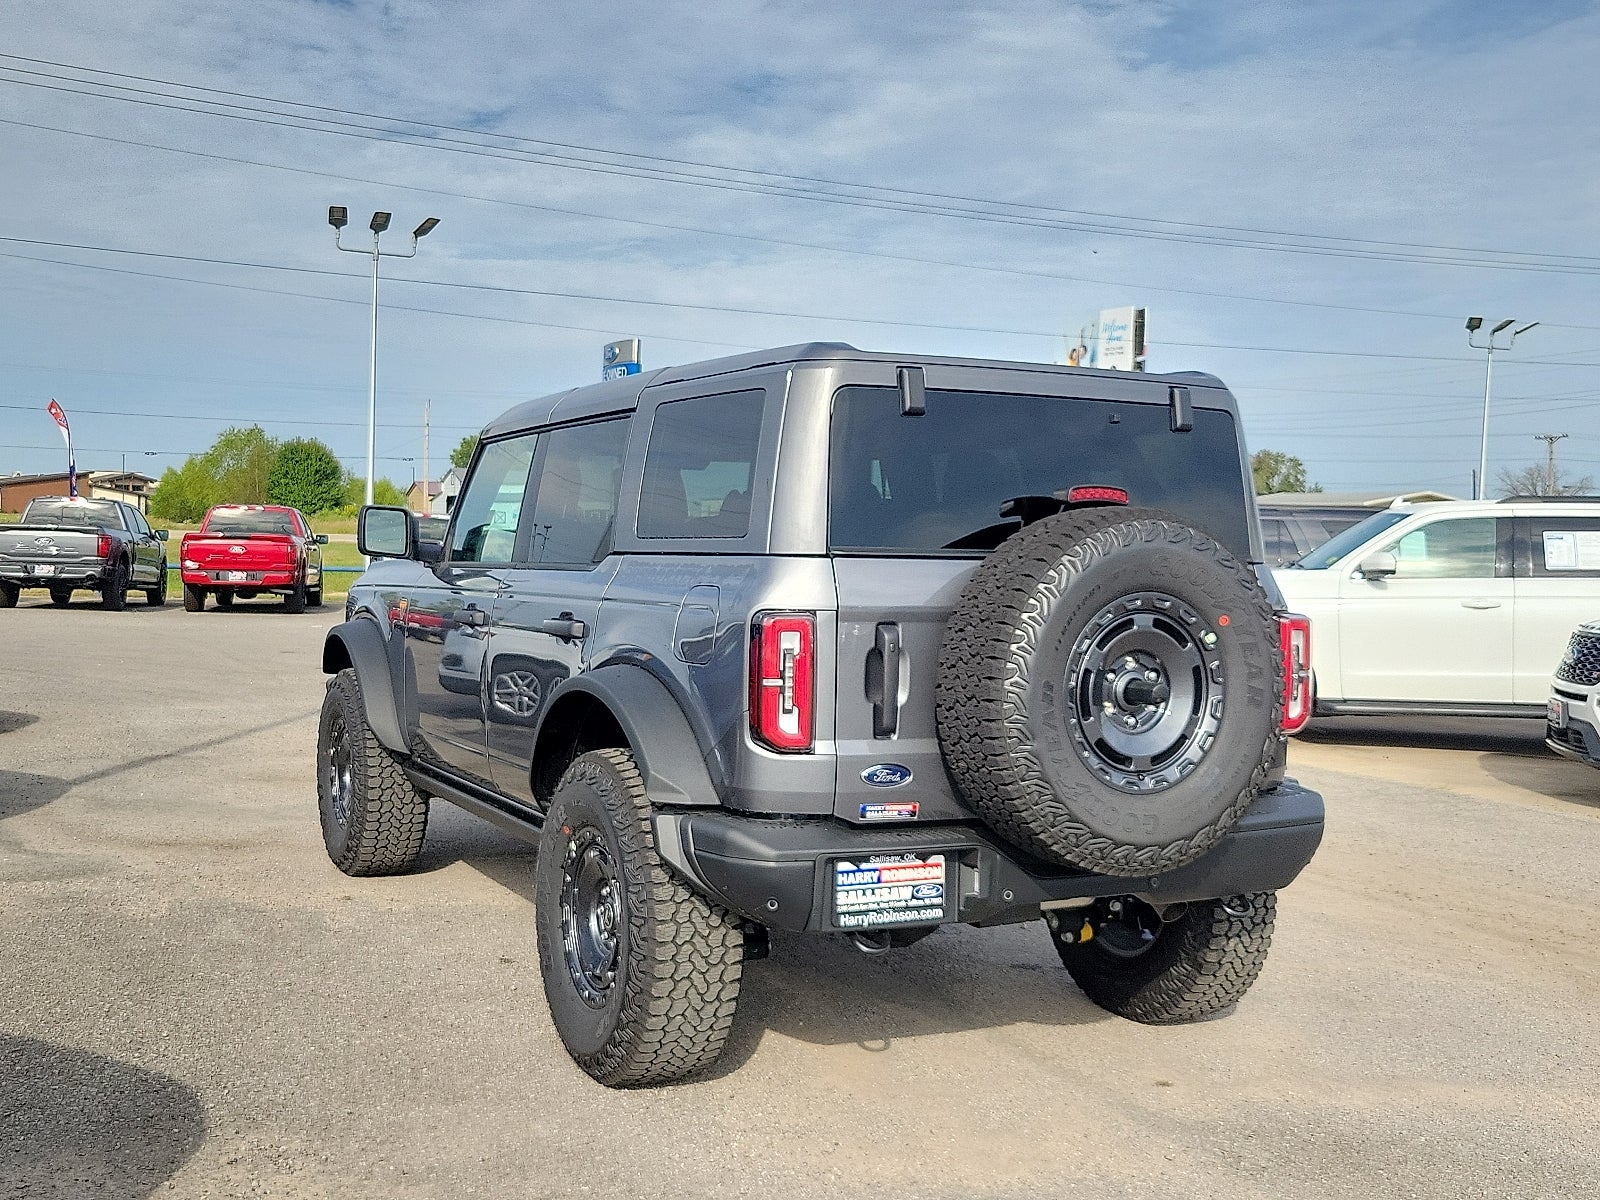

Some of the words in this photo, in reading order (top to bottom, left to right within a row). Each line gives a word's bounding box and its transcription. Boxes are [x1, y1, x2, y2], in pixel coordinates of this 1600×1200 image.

[873, 769, 901, 782] Ford
[869, 855, 901, 864] Sallisaw,
[903, 852, 916, 861] OK
[837, 870, 880, 885] HARRY
[881, 866, 942, 883] ROBINSON
[837, 885, 914, 905] SALLISAW
[840, 908, 943, 927] HarryRobinson.com
